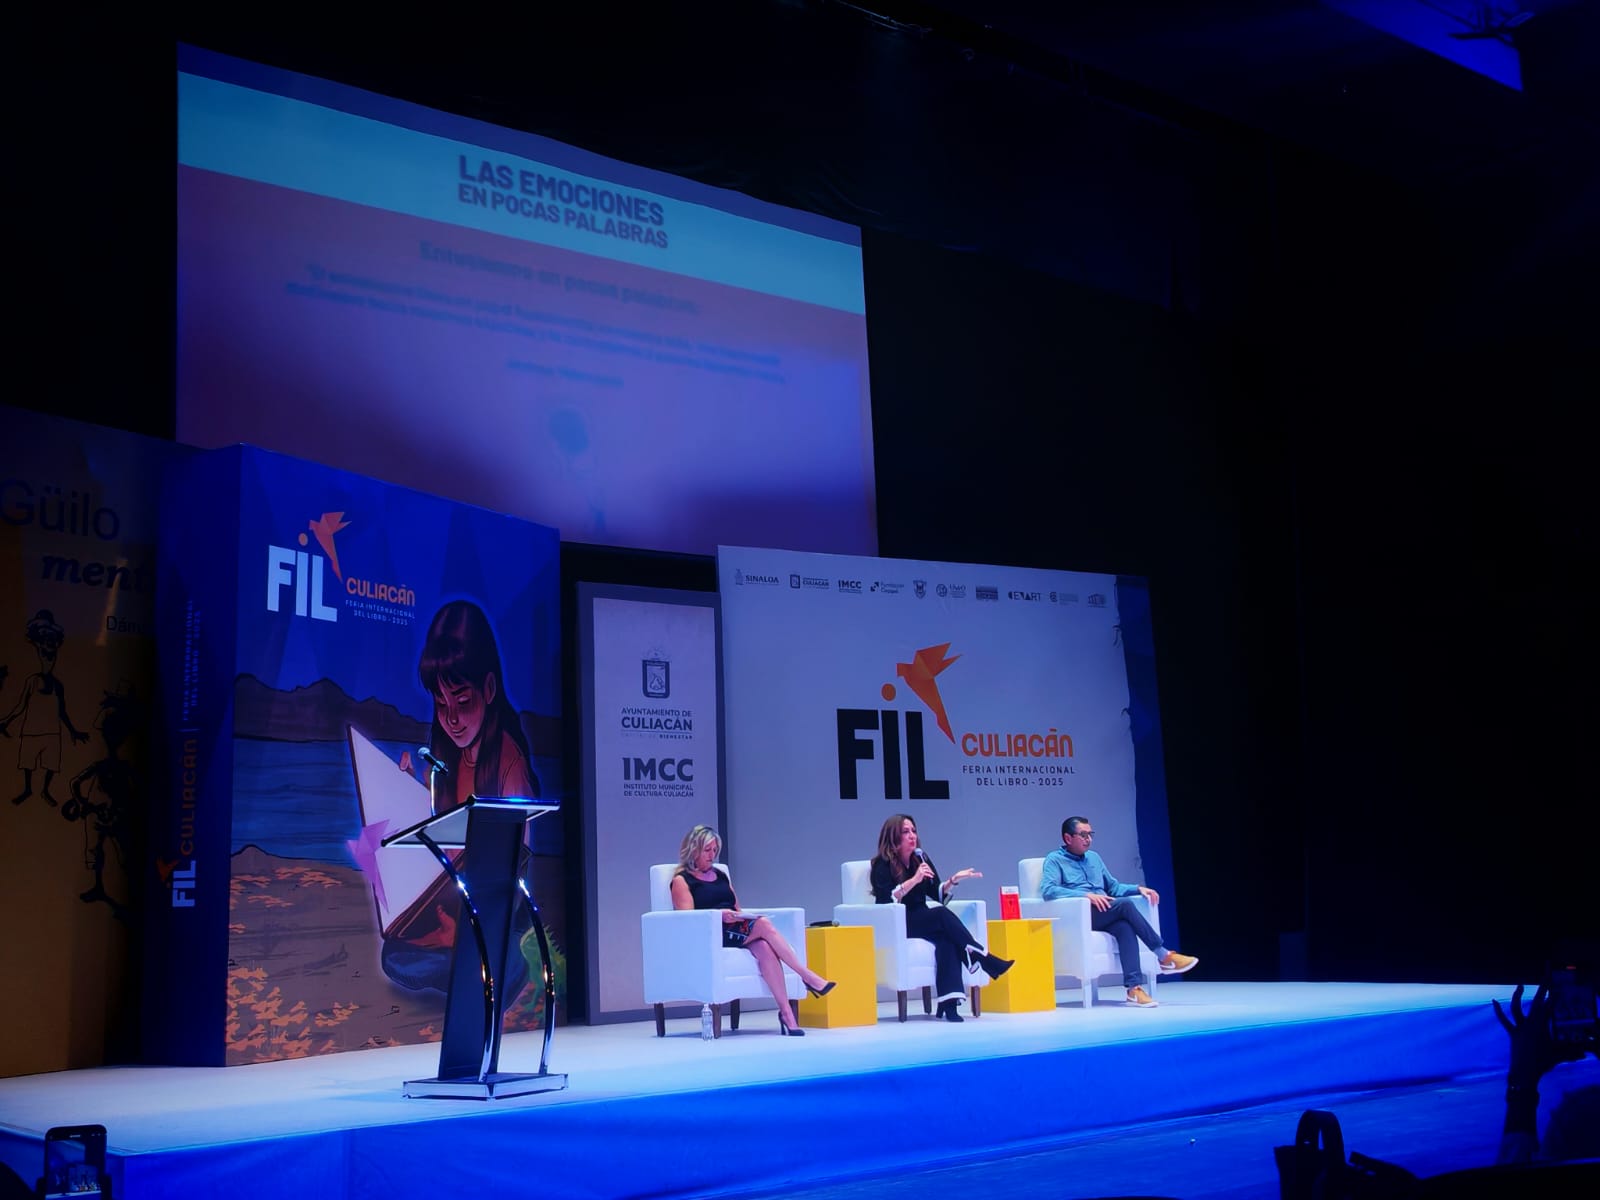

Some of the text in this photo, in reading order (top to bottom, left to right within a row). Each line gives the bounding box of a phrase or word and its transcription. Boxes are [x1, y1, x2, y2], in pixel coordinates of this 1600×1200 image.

[459, 155, 665, 226] LAS EMOCIONES
[458, 183, 668, 249] EN POCAS PALABRAS
[0, 480, 119, 540] Güilo
[42, 555, 155, 593] ment
[267, 533, 338, 622] FIL
[745, 575, 780, 584] SINALOA
[838, 579, 862, 589] IMCC
[346, 577, 416, 607] CULIACÁN
[345, 599, 416, 619] FERIA INTERNACIONAL
[106, 615, 145, 635] Dám
[621, 706, 680, 716] AYUNTAMIENTO
[621, 716, 692, 731] CULIACÁN
[837, 683, 950, 799] FIL
[961, 728, 1073, 757] CULIACÁN
[622, 757, 694, 782] IMCC
[962, 765, 1075, 774] FERIA INTERNACIONAL
[976, 777, 994, 786] DEL
[998, 777, 1028, 787] LIBRO
[1039, 777, 1064, 786] 2025
[168, 860, 196, 907] FIL
